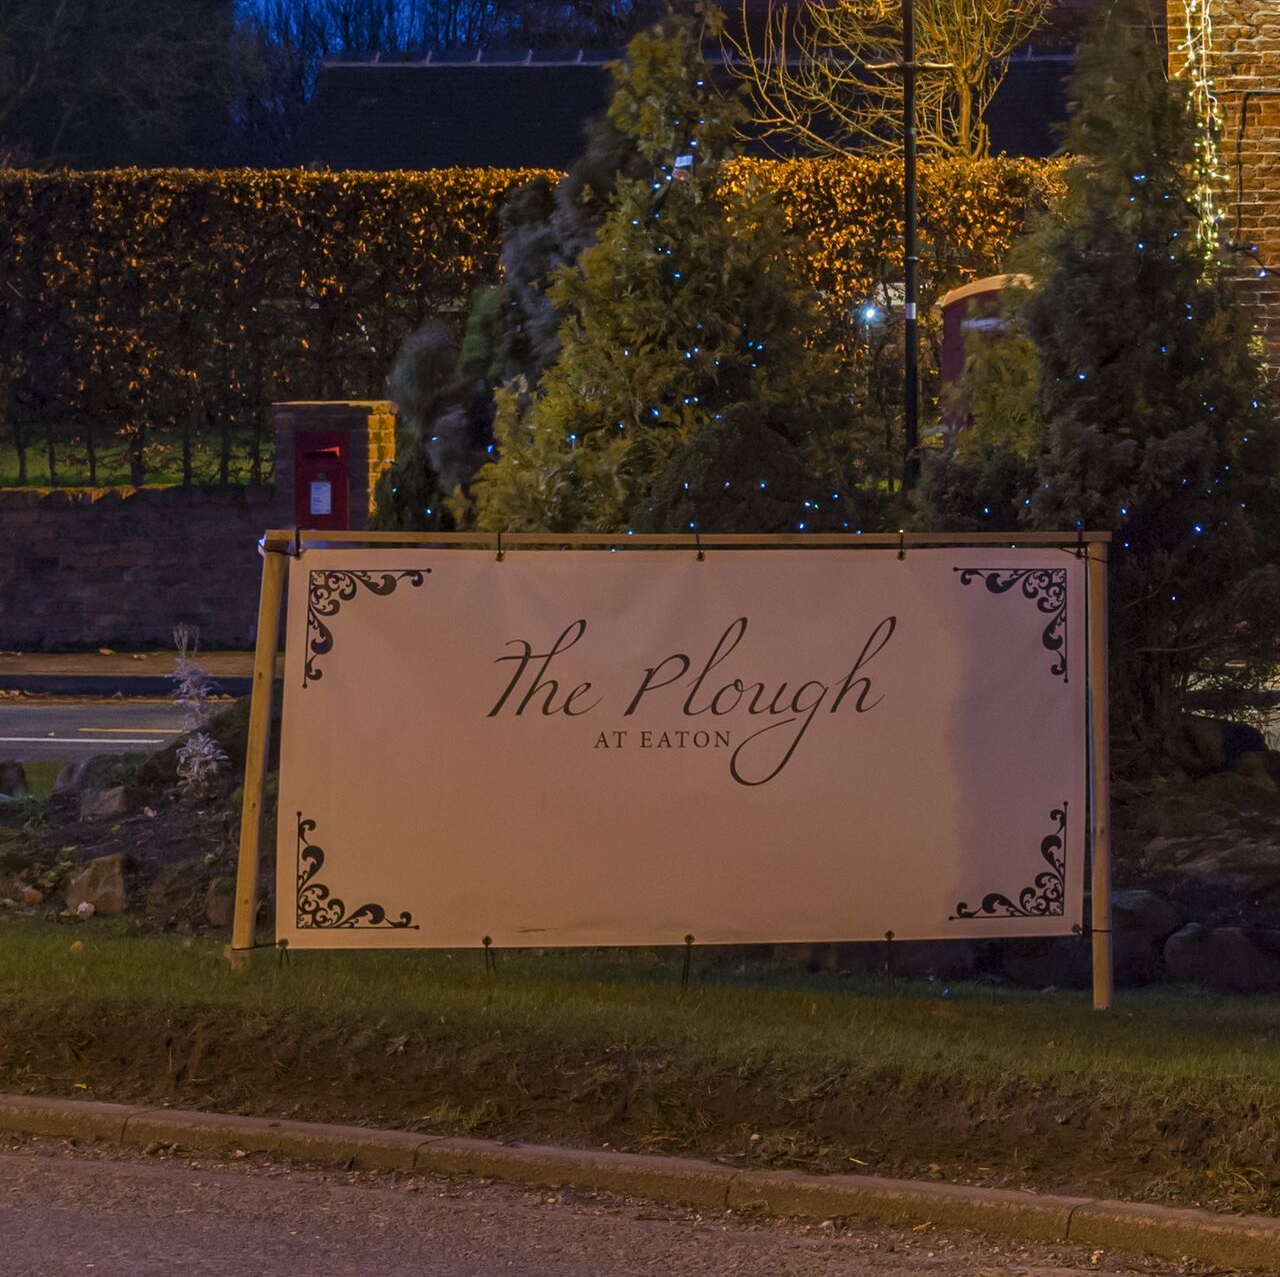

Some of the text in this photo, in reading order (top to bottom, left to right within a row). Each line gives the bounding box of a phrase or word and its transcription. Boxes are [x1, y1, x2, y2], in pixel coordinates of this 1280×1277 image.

[486, 616, 897, 786] The Plough
[593, 730, 732, 749] AT EATON
